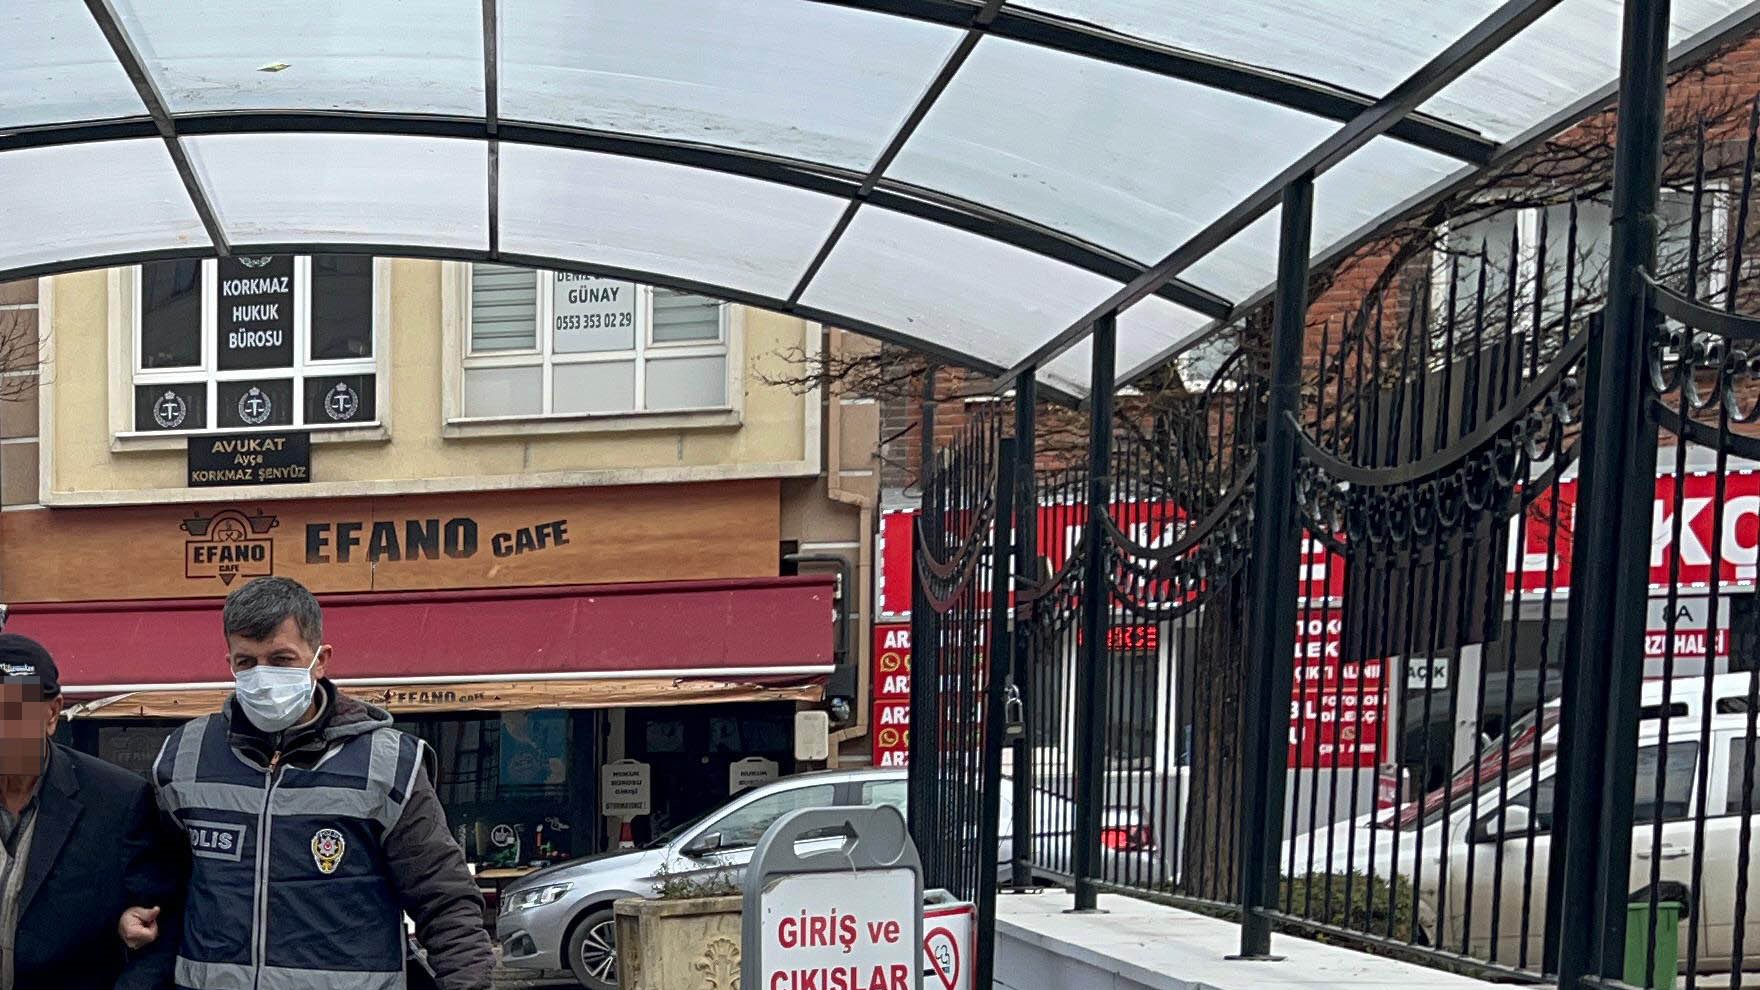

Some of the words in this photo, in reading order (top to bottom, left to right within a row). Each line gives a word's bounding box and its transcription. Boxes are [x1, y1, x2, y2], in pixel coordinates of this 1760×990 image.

[223, 277, 289, 296] KORKMAZ
[568, 285, 620, 304] GÜNAY
[233, 304, 279, 322] HUKUK
[556, 314, 580, 330] 0553
[583, 313, 601, 329] 353
[604, 312, 617, 328] 02
[619, 311, 632, 327] 29
[229, 328, 282, 348] BÜROSU
[211, 437, 286, 453] AVUKAT
[191, 469, 253, 482] KORKMAZ
[258, 464, 307, 482] ŞENYÜZ
[306, 517, 478, 564] EFANO
[491, 519, 571, 558] CAFE
[194, 543, 265, 564] EFANO
[1408, 664, 1445, 682] AÇK
[189, 829, 233, 850] OLIS
[778, 909, 857, 954] GİRİŞ
[868, 920, 900, 944] ve
